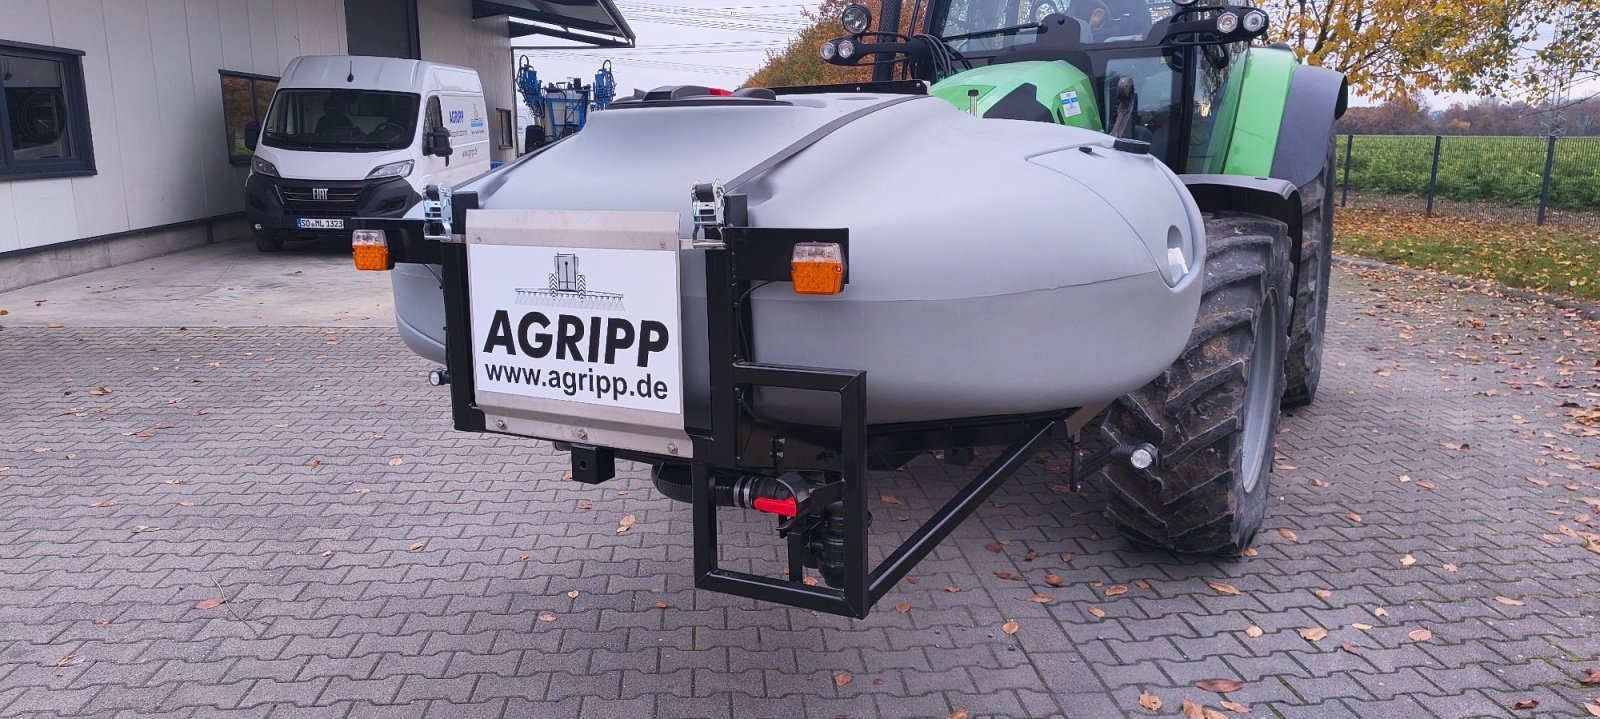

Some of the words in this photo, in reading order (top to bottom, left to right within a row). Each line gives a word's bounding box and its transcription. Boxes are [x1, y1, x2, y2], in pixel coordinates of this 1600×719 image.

[312, 188, 329, 200] FIAT
[301, 219, 311, 227] SO
[325, 220, 343, 228] 1323
[483, 309, 669, 367] AGRIPP
[485, 363, 668, 400] www.agripp.de
